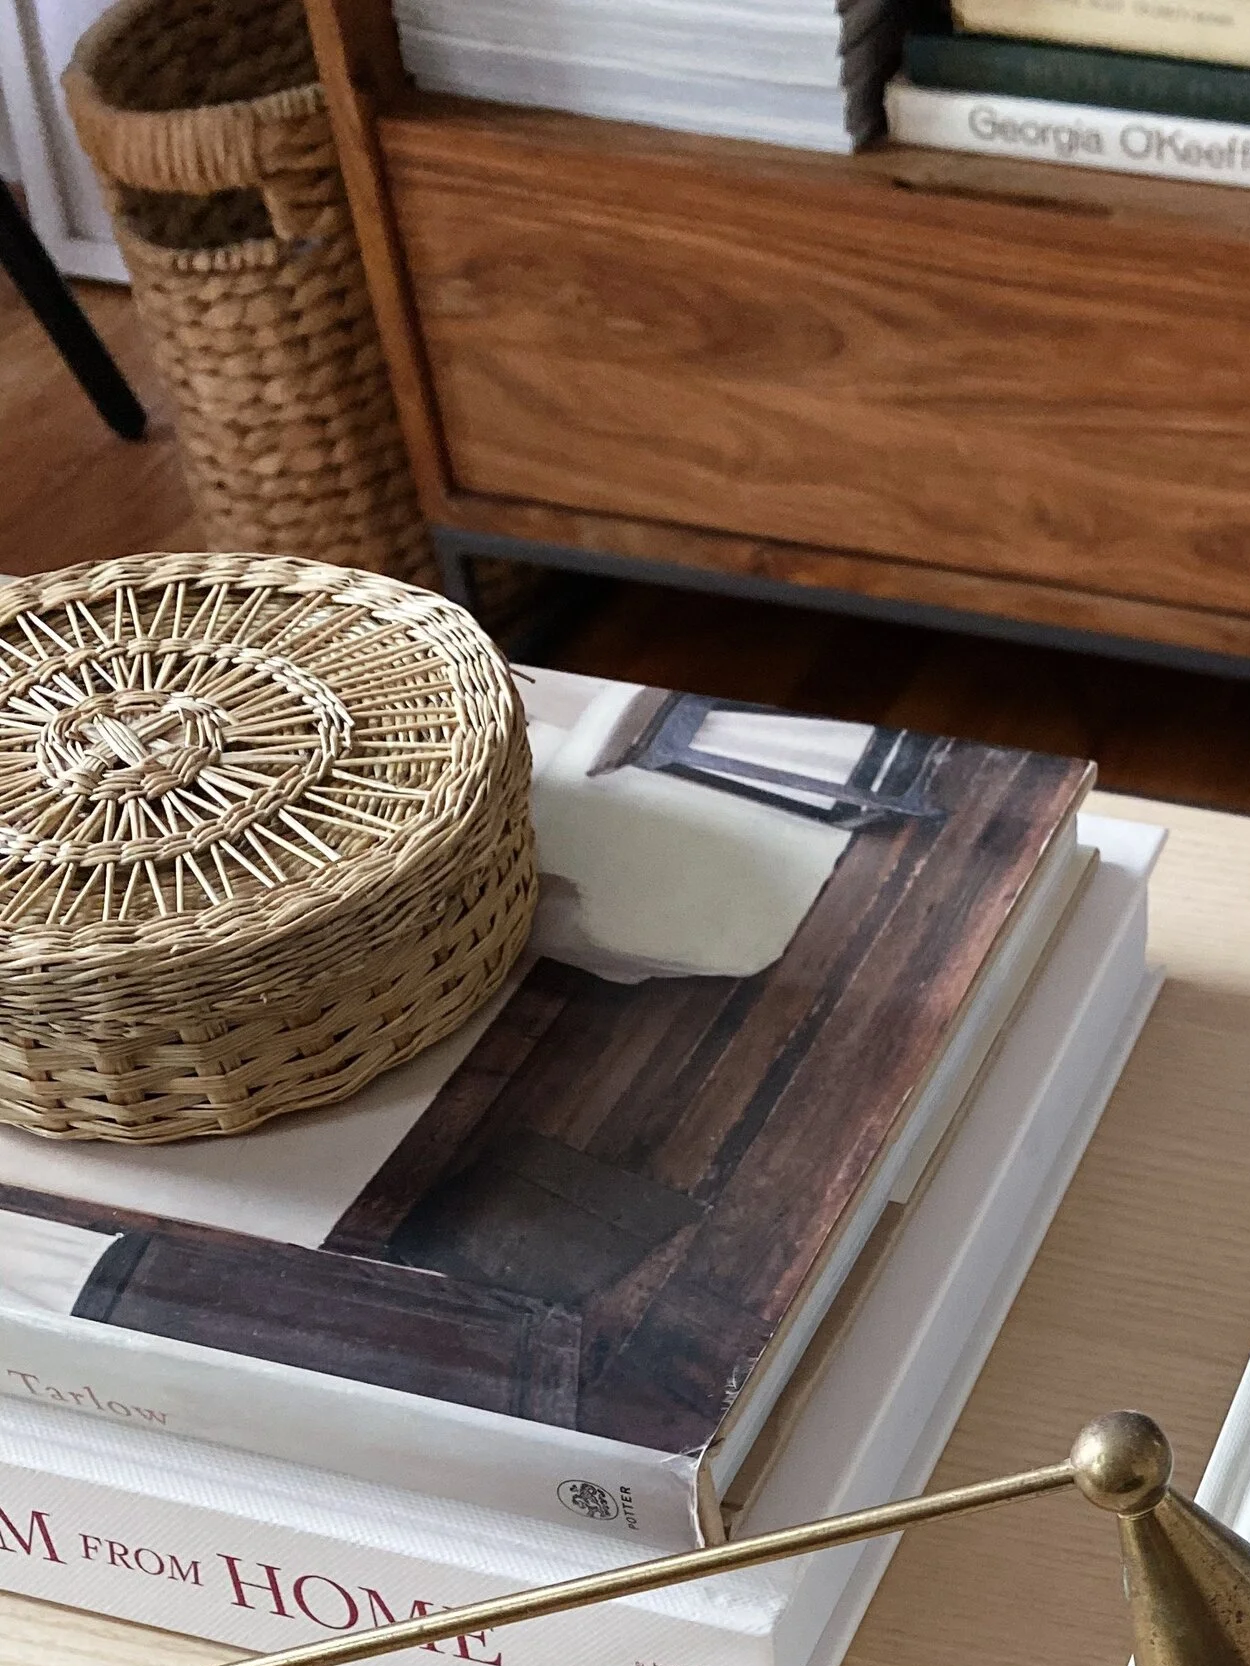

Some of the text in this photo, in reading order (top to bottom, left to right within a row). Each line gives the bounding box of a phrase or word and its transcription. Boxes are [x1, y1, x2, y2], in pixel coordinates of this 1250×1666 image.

[967, 103, 1104, 158] Georgia
[7, 1368, 169, 1426] Tarlow
[620, 1485, 639, 1531] POTTER
[78, 1532, 205, 1587] FROM
